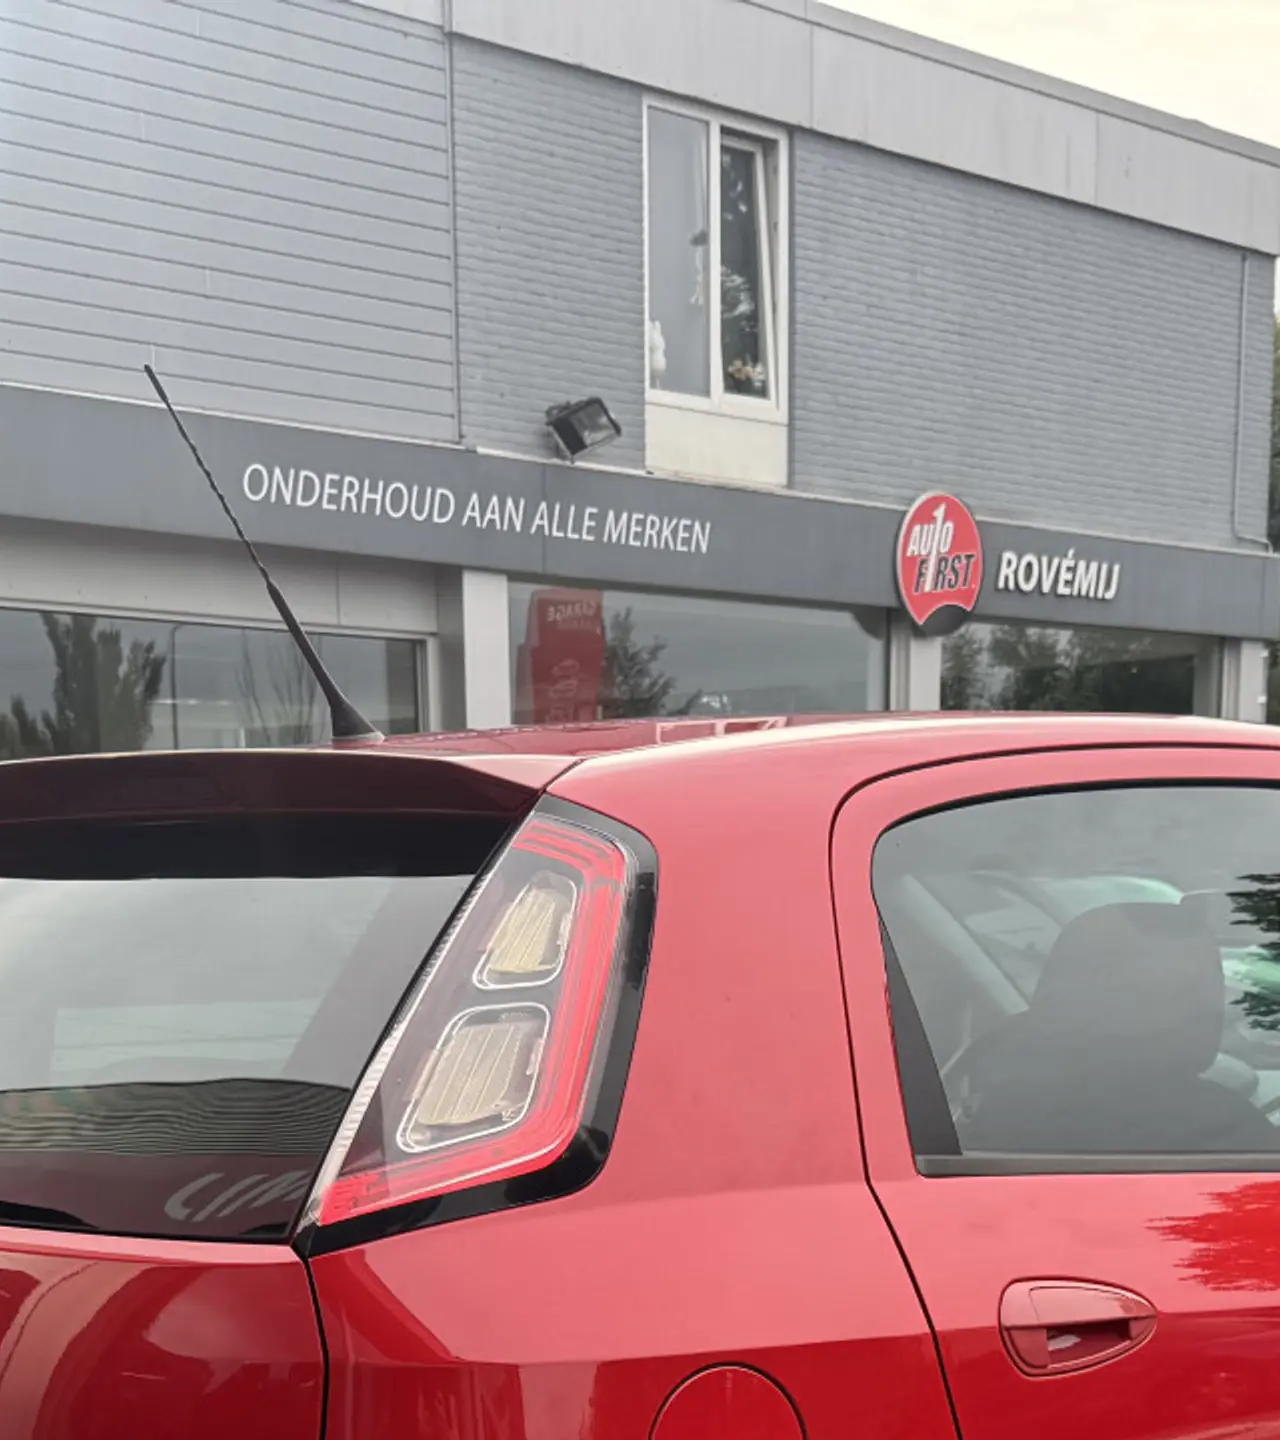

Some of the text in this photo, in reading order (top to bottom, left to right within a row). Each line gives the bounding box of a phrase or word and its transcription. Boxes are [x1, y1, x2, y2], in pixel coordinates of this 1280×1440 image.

[243, 463, 711, 555] ONDERHOUD AAN ALLE MERKEN
[997, 547, 1121, 600] ROVÉMIJ
